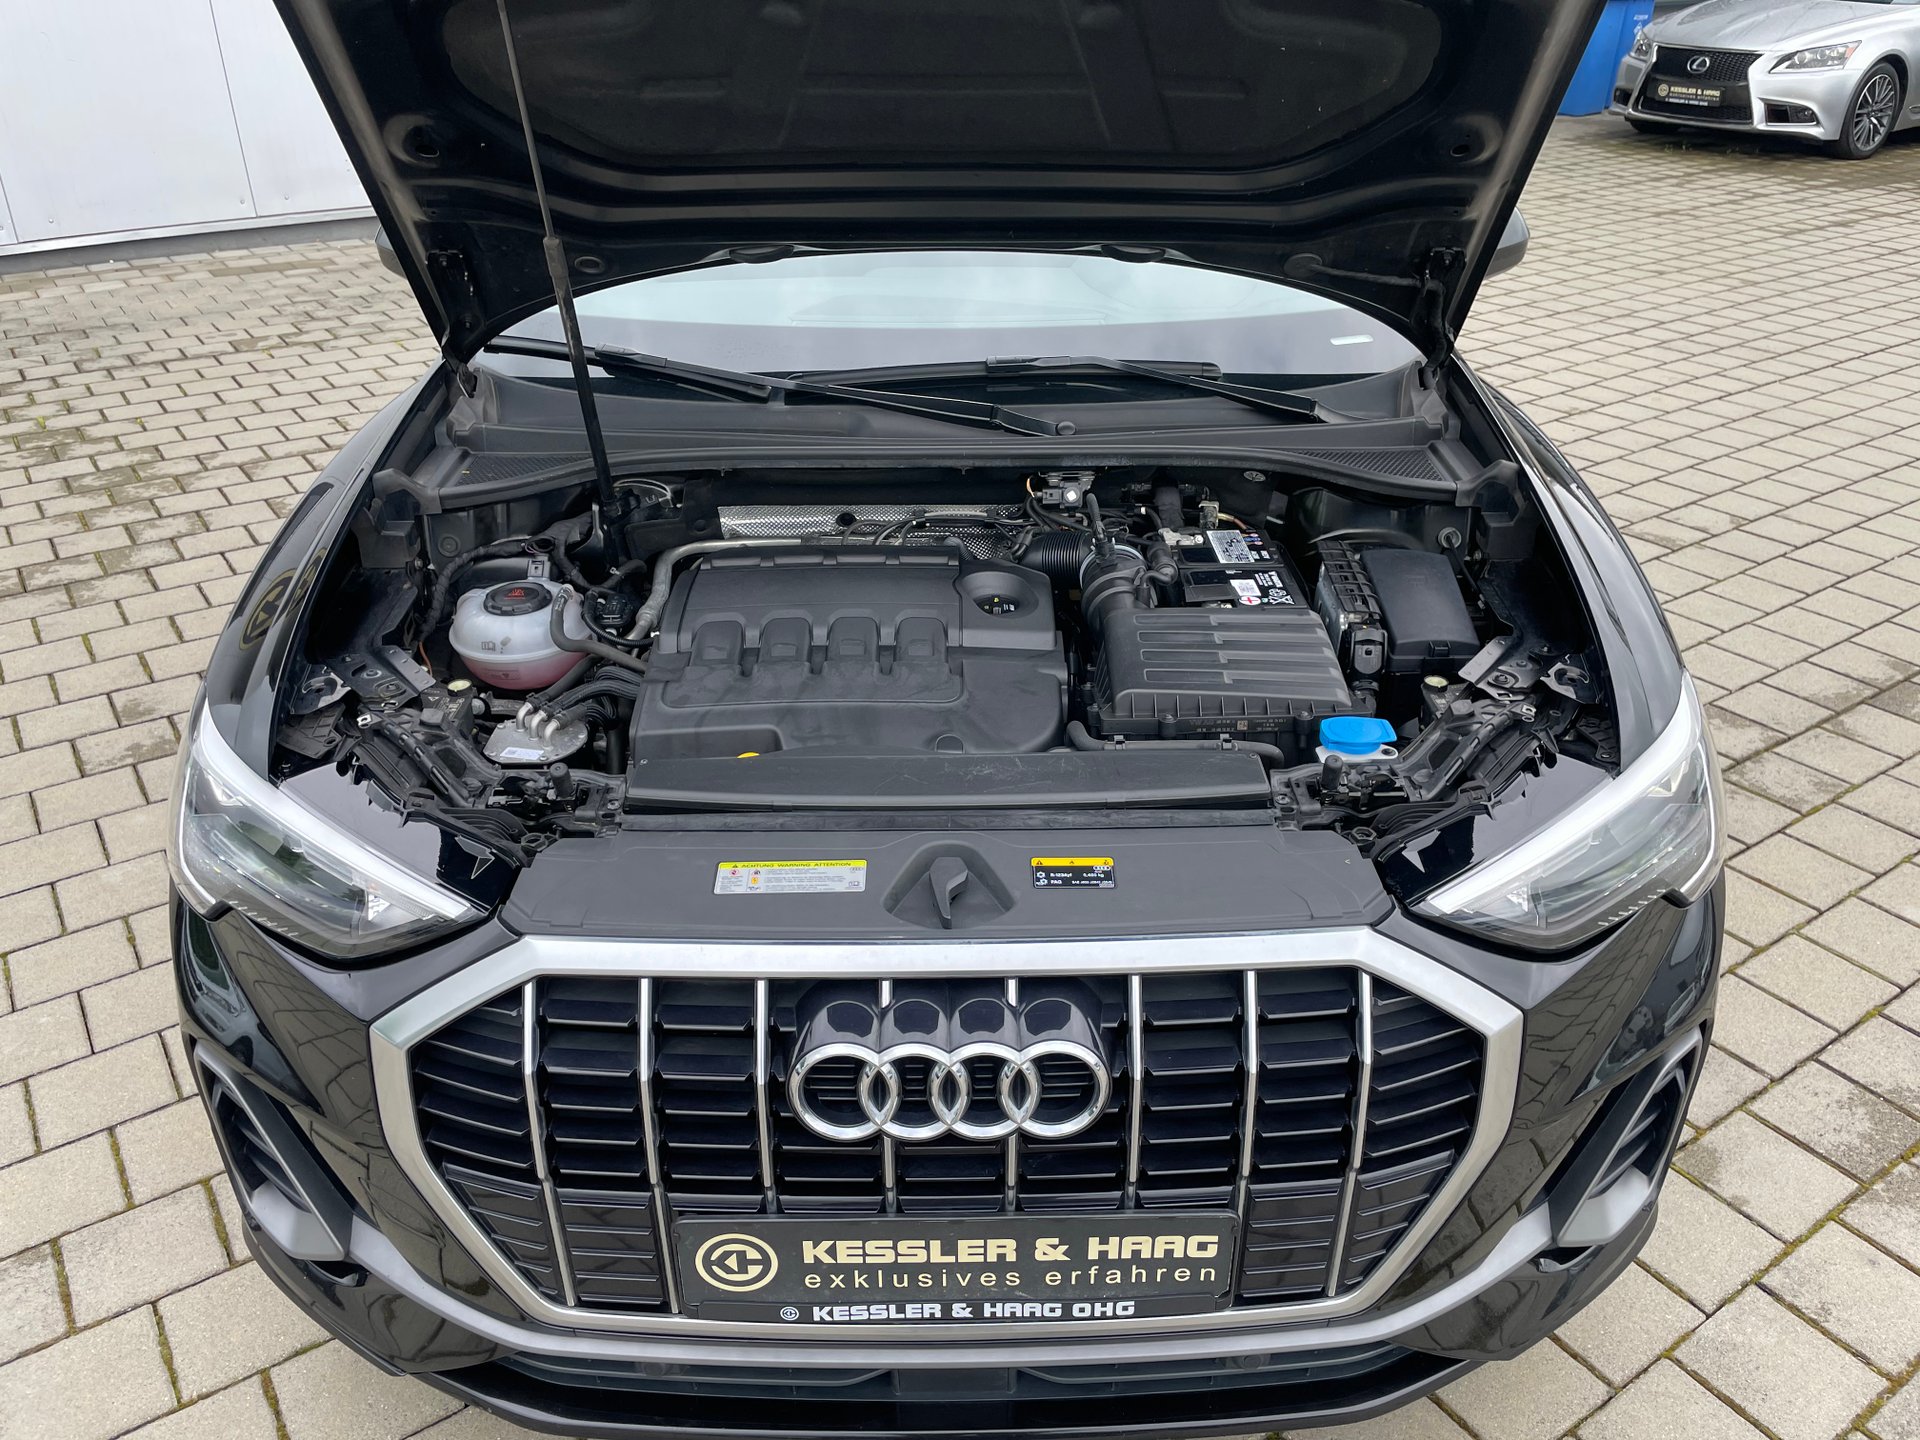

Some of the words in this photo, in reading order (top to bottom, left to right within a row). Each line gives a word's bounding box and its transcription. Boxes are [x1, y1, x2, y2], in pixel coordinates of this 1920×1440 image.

[802, 1239, 1017, 1264] KESSLER
[1034, 1237, 1071, 1261] &
[1088, 1235, 1219, 1260] HAAG
[804, 1269, 1020, 1289] exklusives
[1045, 1265, 1215, 1286] erfahren
[812, 1303, 942, 1321] KESSLER
[951, 1302, 974, 1318] &
[983, 1303, 1062, 1317] HAAG
[1072, 1301, 1135, 1317] OHG
